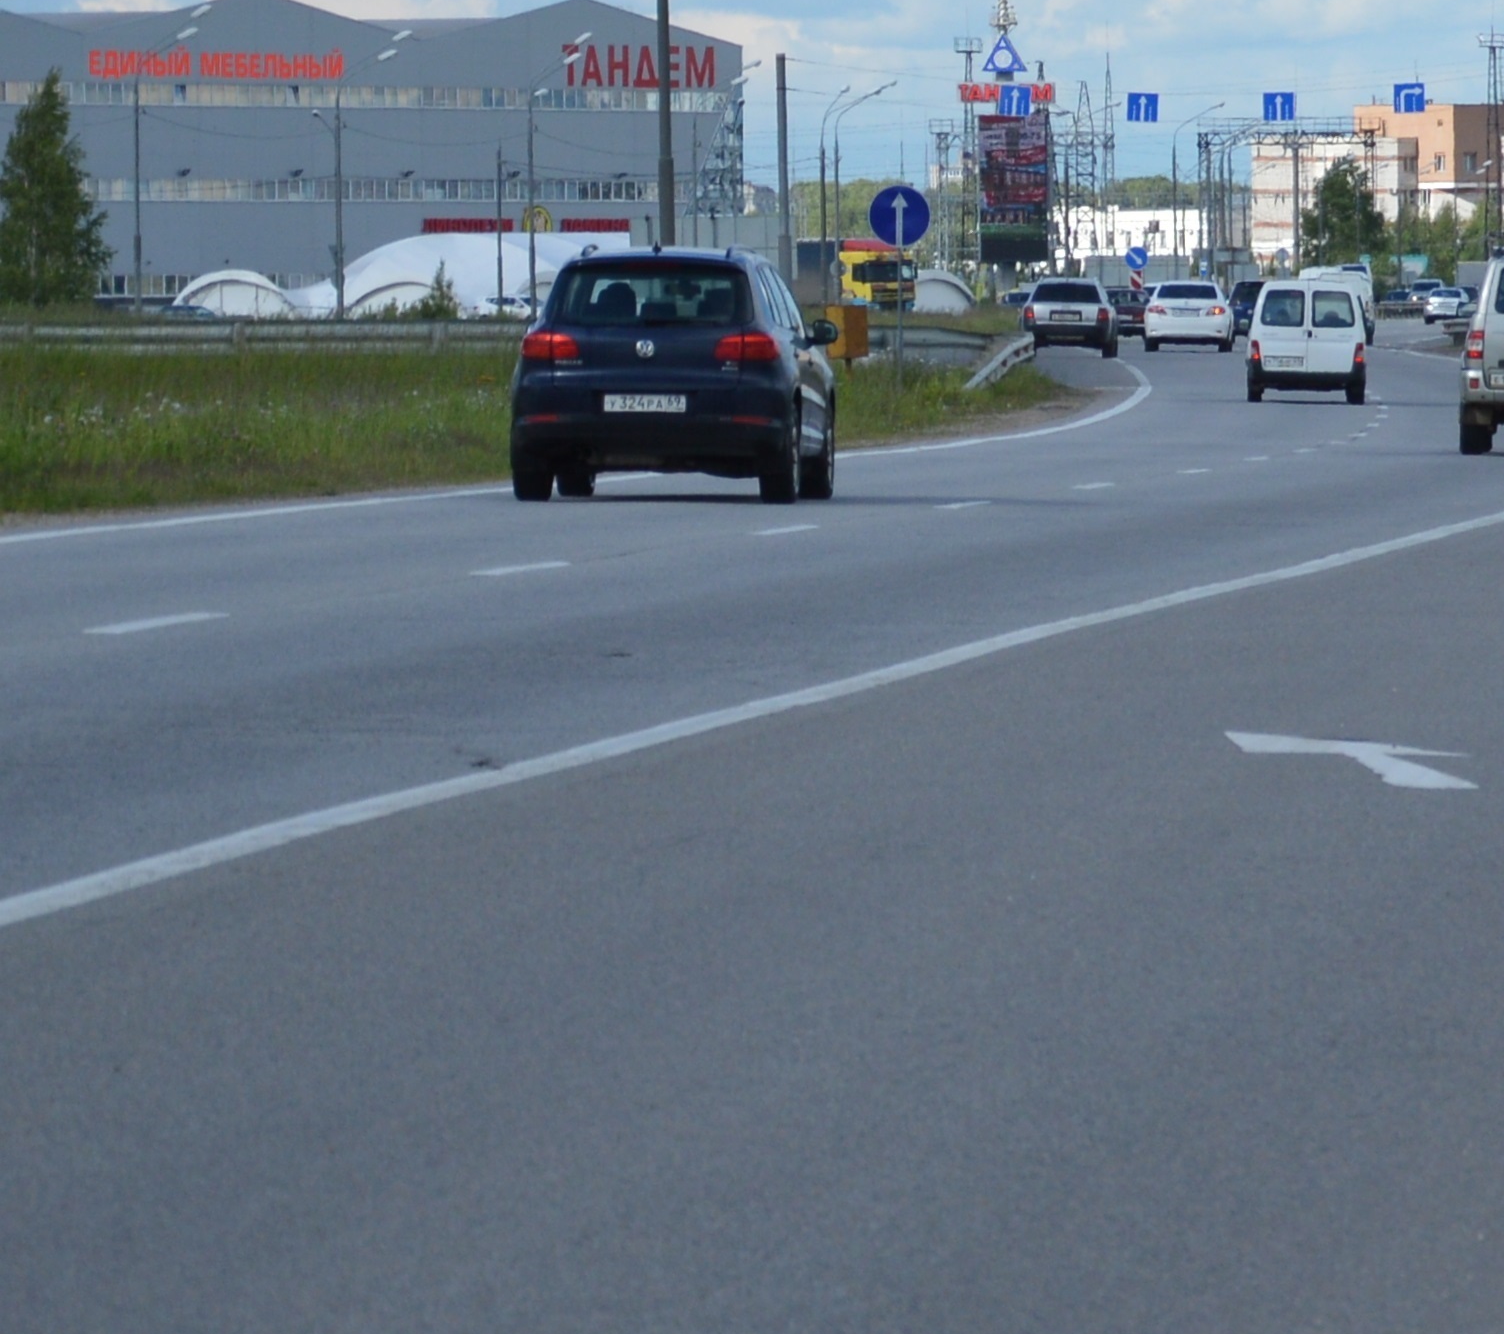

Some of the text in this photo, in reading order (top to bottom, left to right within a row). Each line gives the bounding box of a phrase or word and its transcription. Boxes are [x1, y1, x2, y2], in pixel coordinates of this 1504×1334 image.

[88, 45, 344, 80] ЕДИНЫЙ МЕБЕЛЬНЫЙ
[958, 82, 1053, 102] ТАНМ
